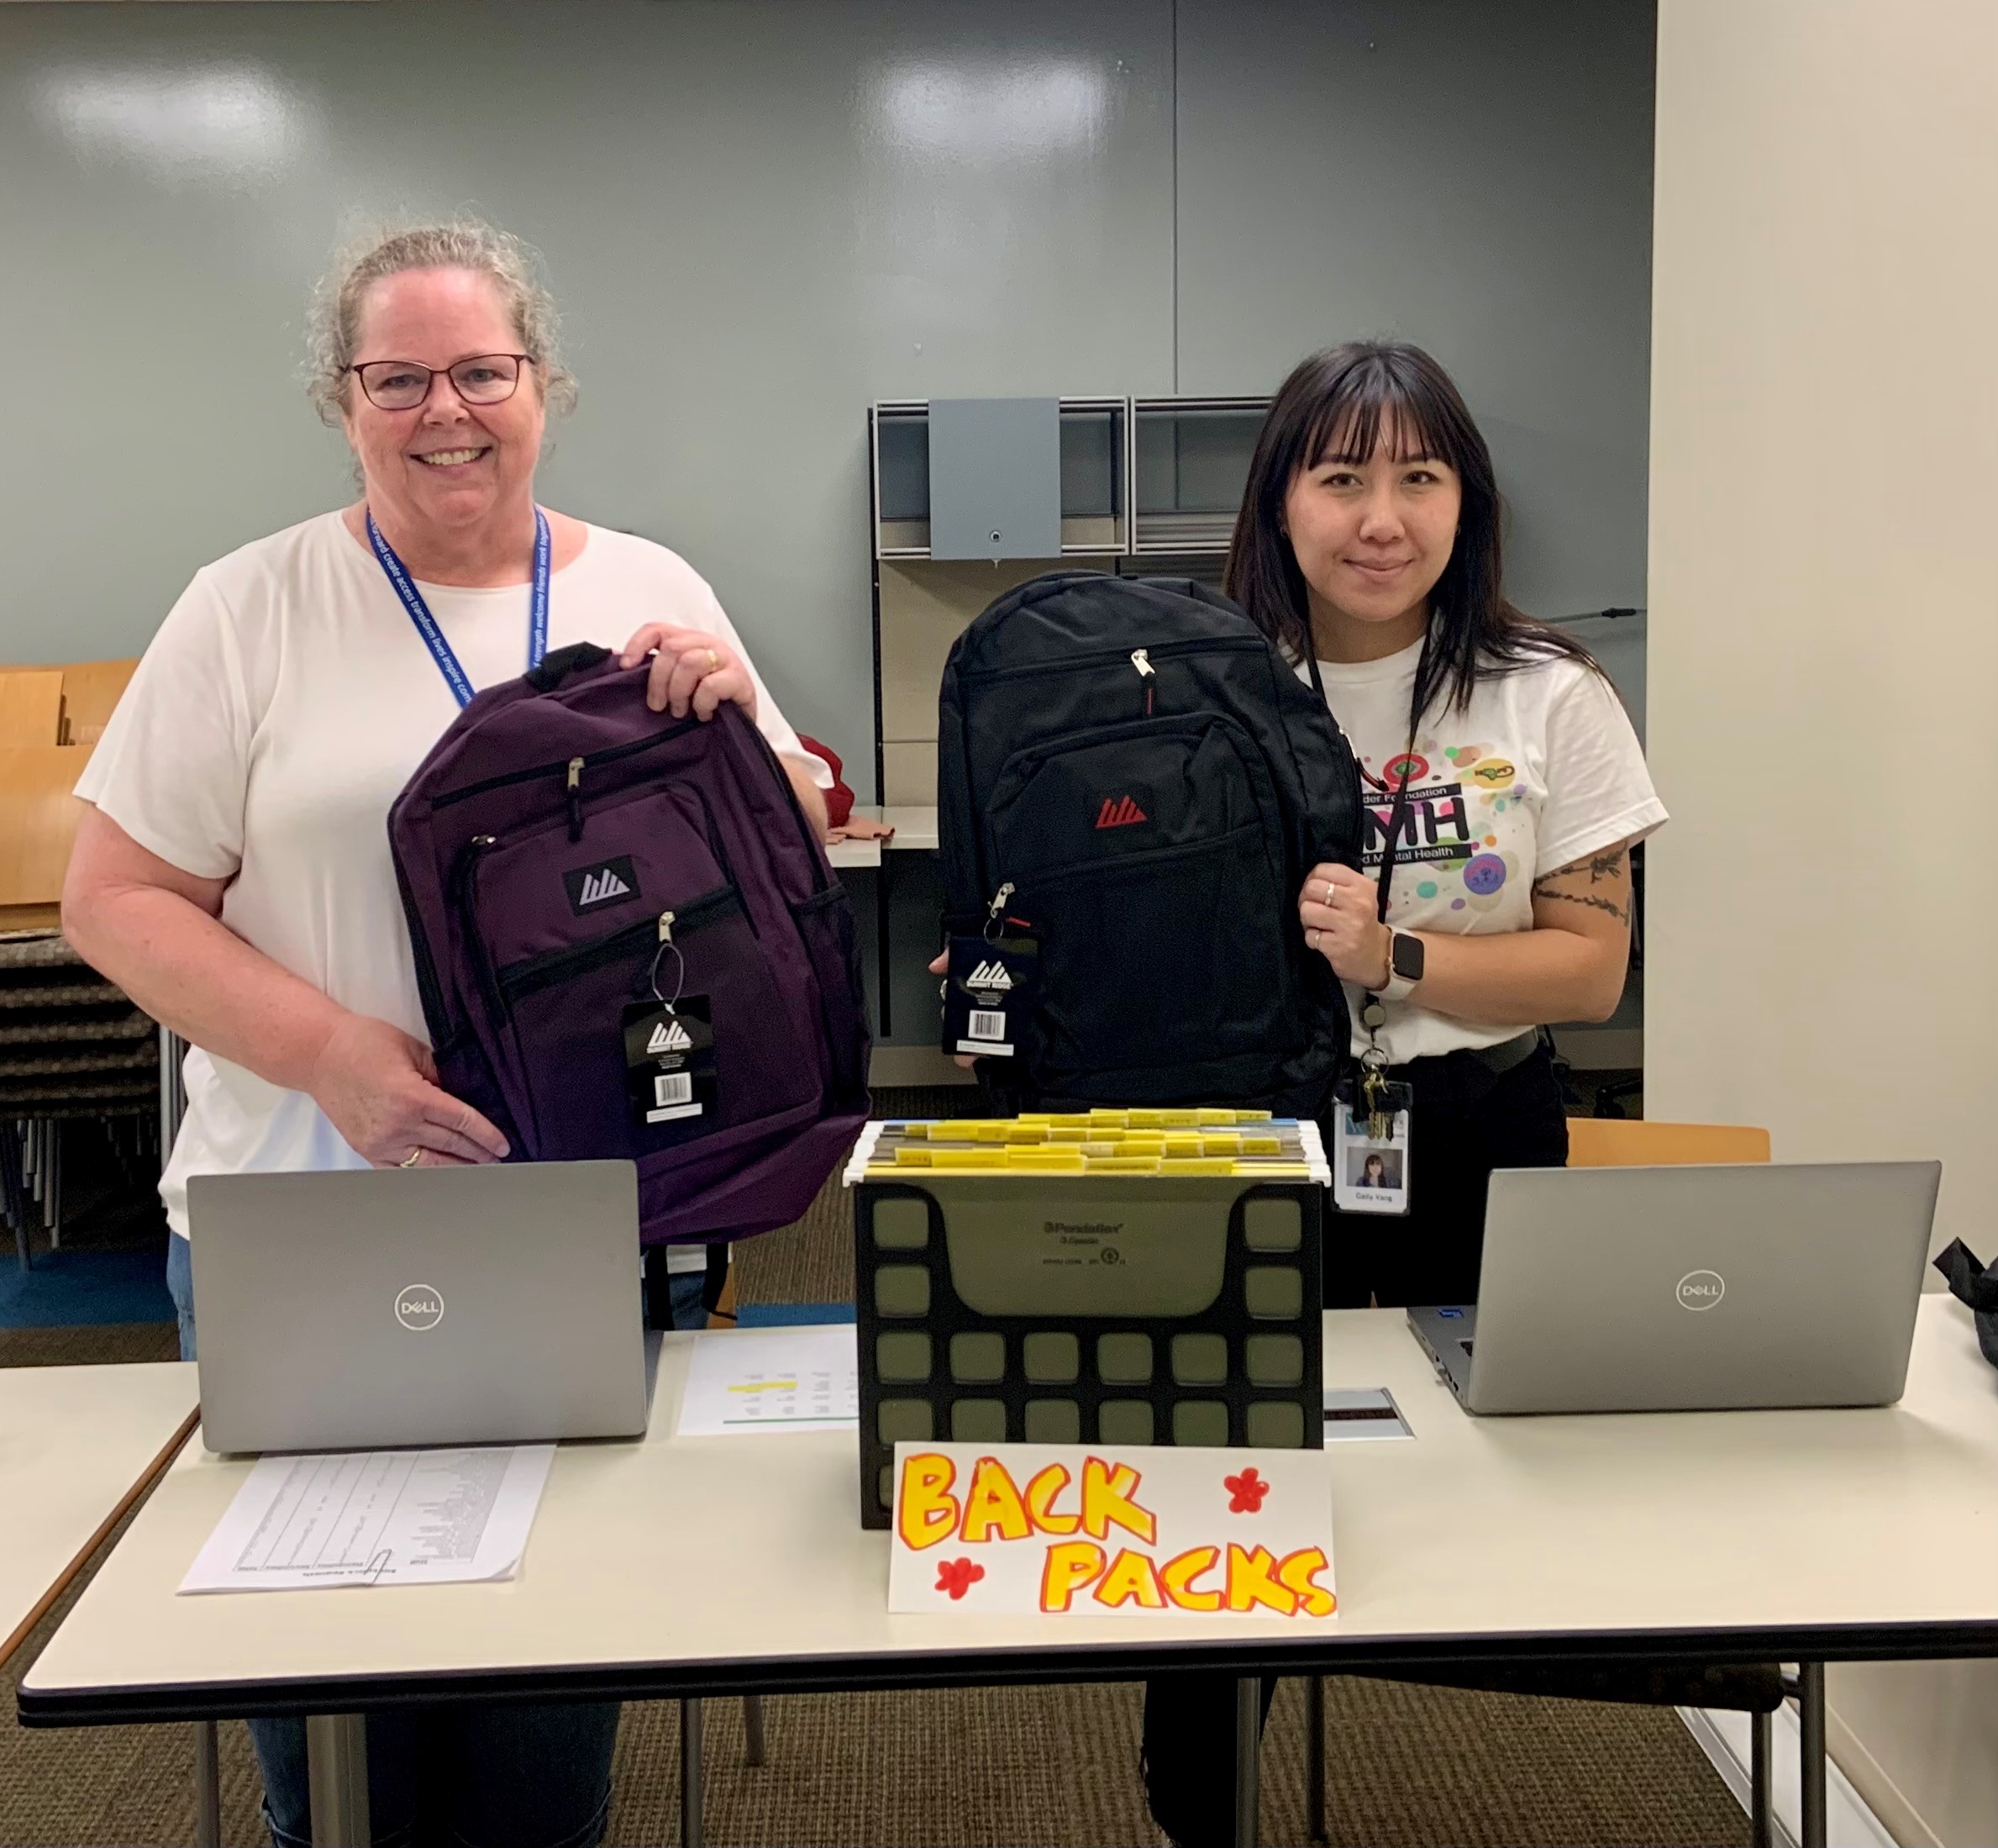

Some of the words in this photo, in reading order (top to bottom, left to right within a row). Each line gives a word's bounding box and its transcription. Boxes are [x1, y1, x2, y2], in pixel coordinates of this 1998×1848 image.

[539, 546, 548, 566] work
[535, 566, 547, 593] friends
[383, 553, 401, 577] create
[396, 577, 415, 602] access
[410, 600, 436, 640] transform
[432, 637, 447, 656] lives
[442, 655, 462, 684] inspire
[534, 592, 545, 629] welcome
[534, 629, 545, 662] strength
[1415, 847, 1454, 860] Health
[1683, 1284, 1719, 1297] DELL
[401, 1301, 439, 1314] DELL
[898, 1453, 1157, 1551] BACK
[1039, 1540, 1338, 1618] PACKS
